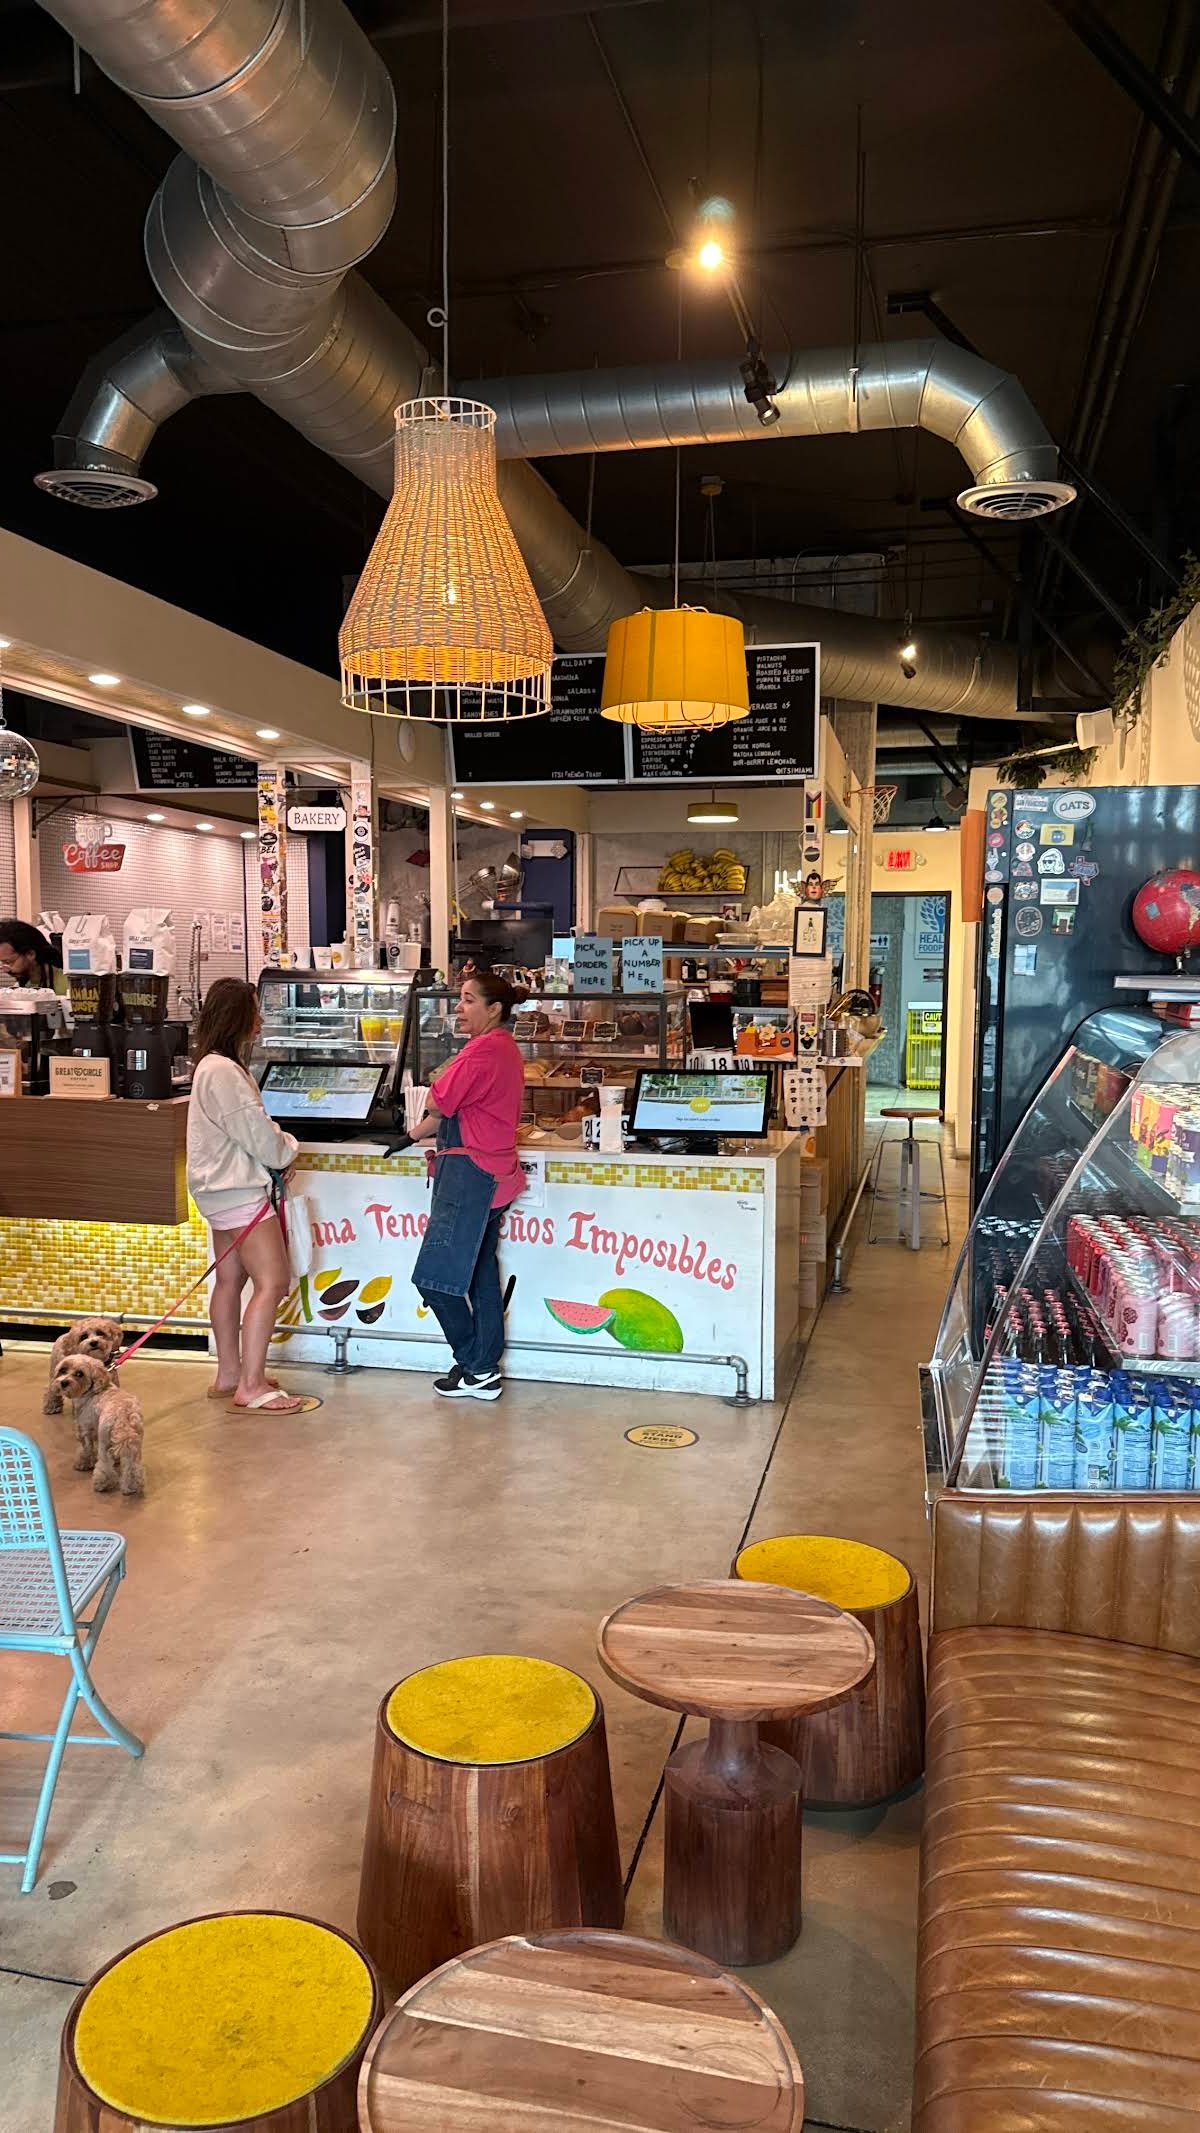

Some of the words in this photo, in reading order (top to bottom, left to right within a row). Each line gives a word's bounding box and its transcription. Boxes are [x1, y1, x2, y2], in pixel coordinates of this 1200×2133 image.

[1059, 801, 1090, 812] OATS
[294, 813, 339, 824] BAKERY
[63, 841, 122, 868] Coffee
[624, 938, 644, 946] PICK
[920, 935, 944, 943] HEAL
[575, 944, 595, 952] PICK
[575, 961, 608, 969] ORDERS
[624, 959, 660, 967] NUMBER
[580, 977, 606, 985] HERE
[628, 971, 657, 988] HERE
[711, 1058, 727, 1070] 18
[55, 1068, 73, 1076] GREAT
[83, 1068, 102, 1076] CIRCLE
[364, 1204, 429, 1240] Tene
[498, 1209, 554, 1245] eños
[565, 1210, 737, 1290] Imposibles
